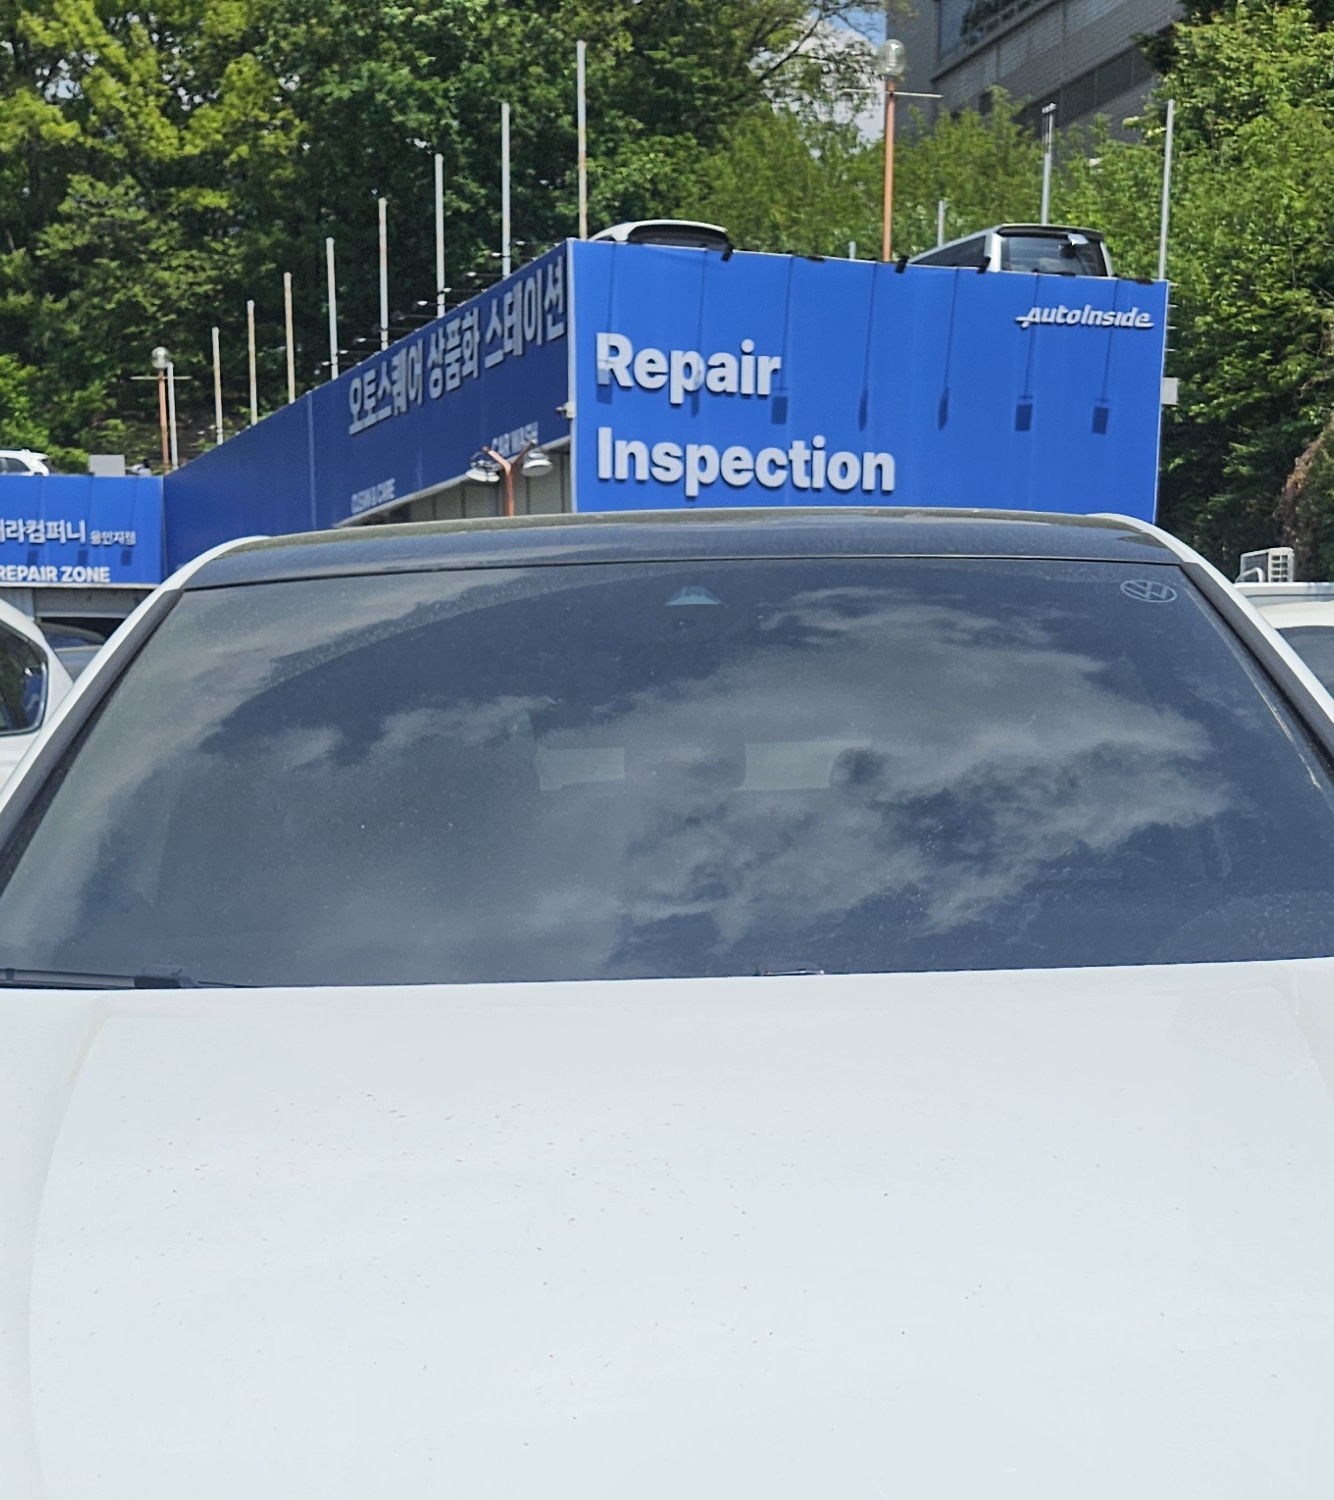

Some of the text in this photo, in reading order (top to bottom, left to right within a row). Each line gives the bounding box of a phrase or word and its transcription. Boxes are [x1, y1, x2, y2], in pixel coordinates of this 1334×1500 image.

[349, 256, 566, 436] 오토스퀘어 상품화 스테이션
[596, 332, 782, 405] Repair
[597, 427, 896, 497] Inspection
[60, 565, 111, 583] ZONE
